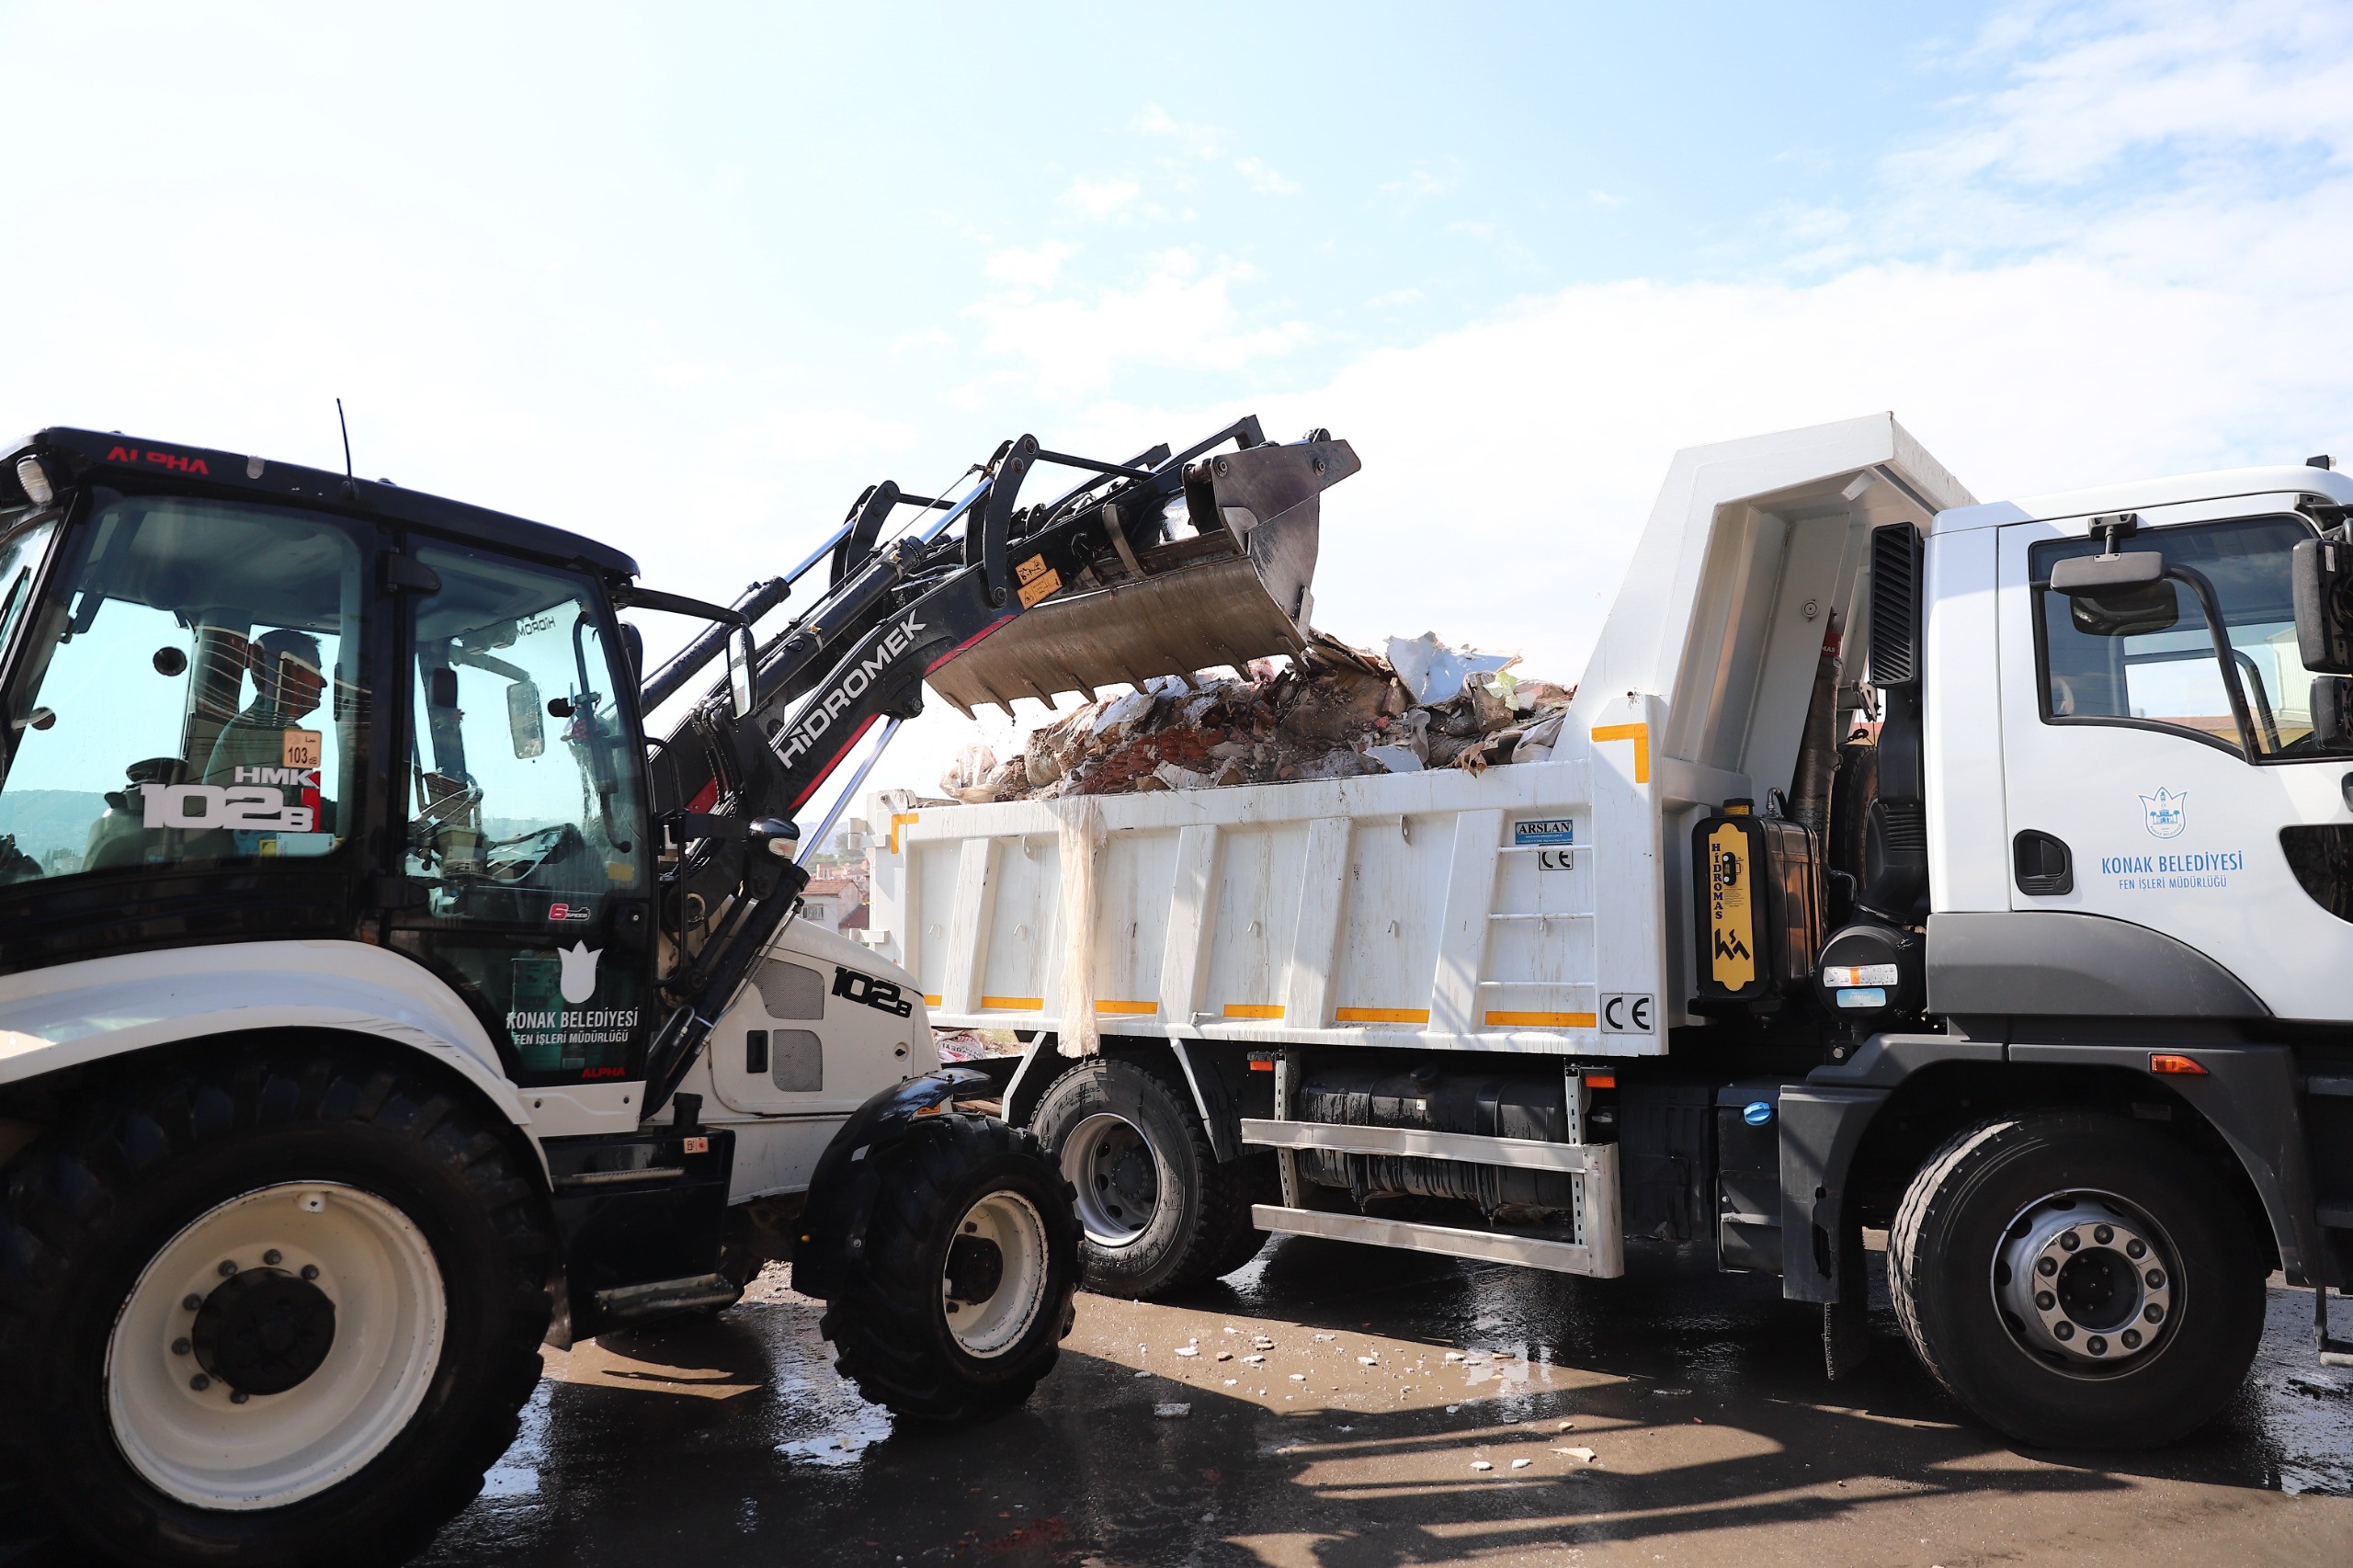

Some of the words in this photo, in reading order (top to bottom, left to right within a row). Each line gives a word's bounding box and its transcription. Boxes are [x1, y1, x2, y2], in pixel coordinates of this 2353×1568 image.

[288, 745, 309, 765] 103
[234, 766, 320, 789] HMK
[141, 783, 314, 832] 102B
[1518, 822, 1570, 835] ARSLAN
[2101, 856, 2154, 874] KONAK
[2158, 850, 2244, 872] BELEDİYESİ
[2119, 879, 2135, 890] FEN
[2139, 876, 2165, 892] İŞLERİ
[2168, 874, 2227, 889] MÜDÜRLÜĞÜ
[549, 903, 569, 920] 6
[831, 965, 913, 1018] 102B
[506, 1011, 556, 1029] KONAK
[560, 1006, 639, 1028] BELEDİYESİ
[1605, 997, 1651, 1030] CE
[514, 1034, 534, 1045] FEN
[535, 1030, 567, 1046] İŞLERİ
[569, 1028, 629, 1044] MÜDÜRLÜĞÜ
[581, 1067, 626, 1078] ALPHA
